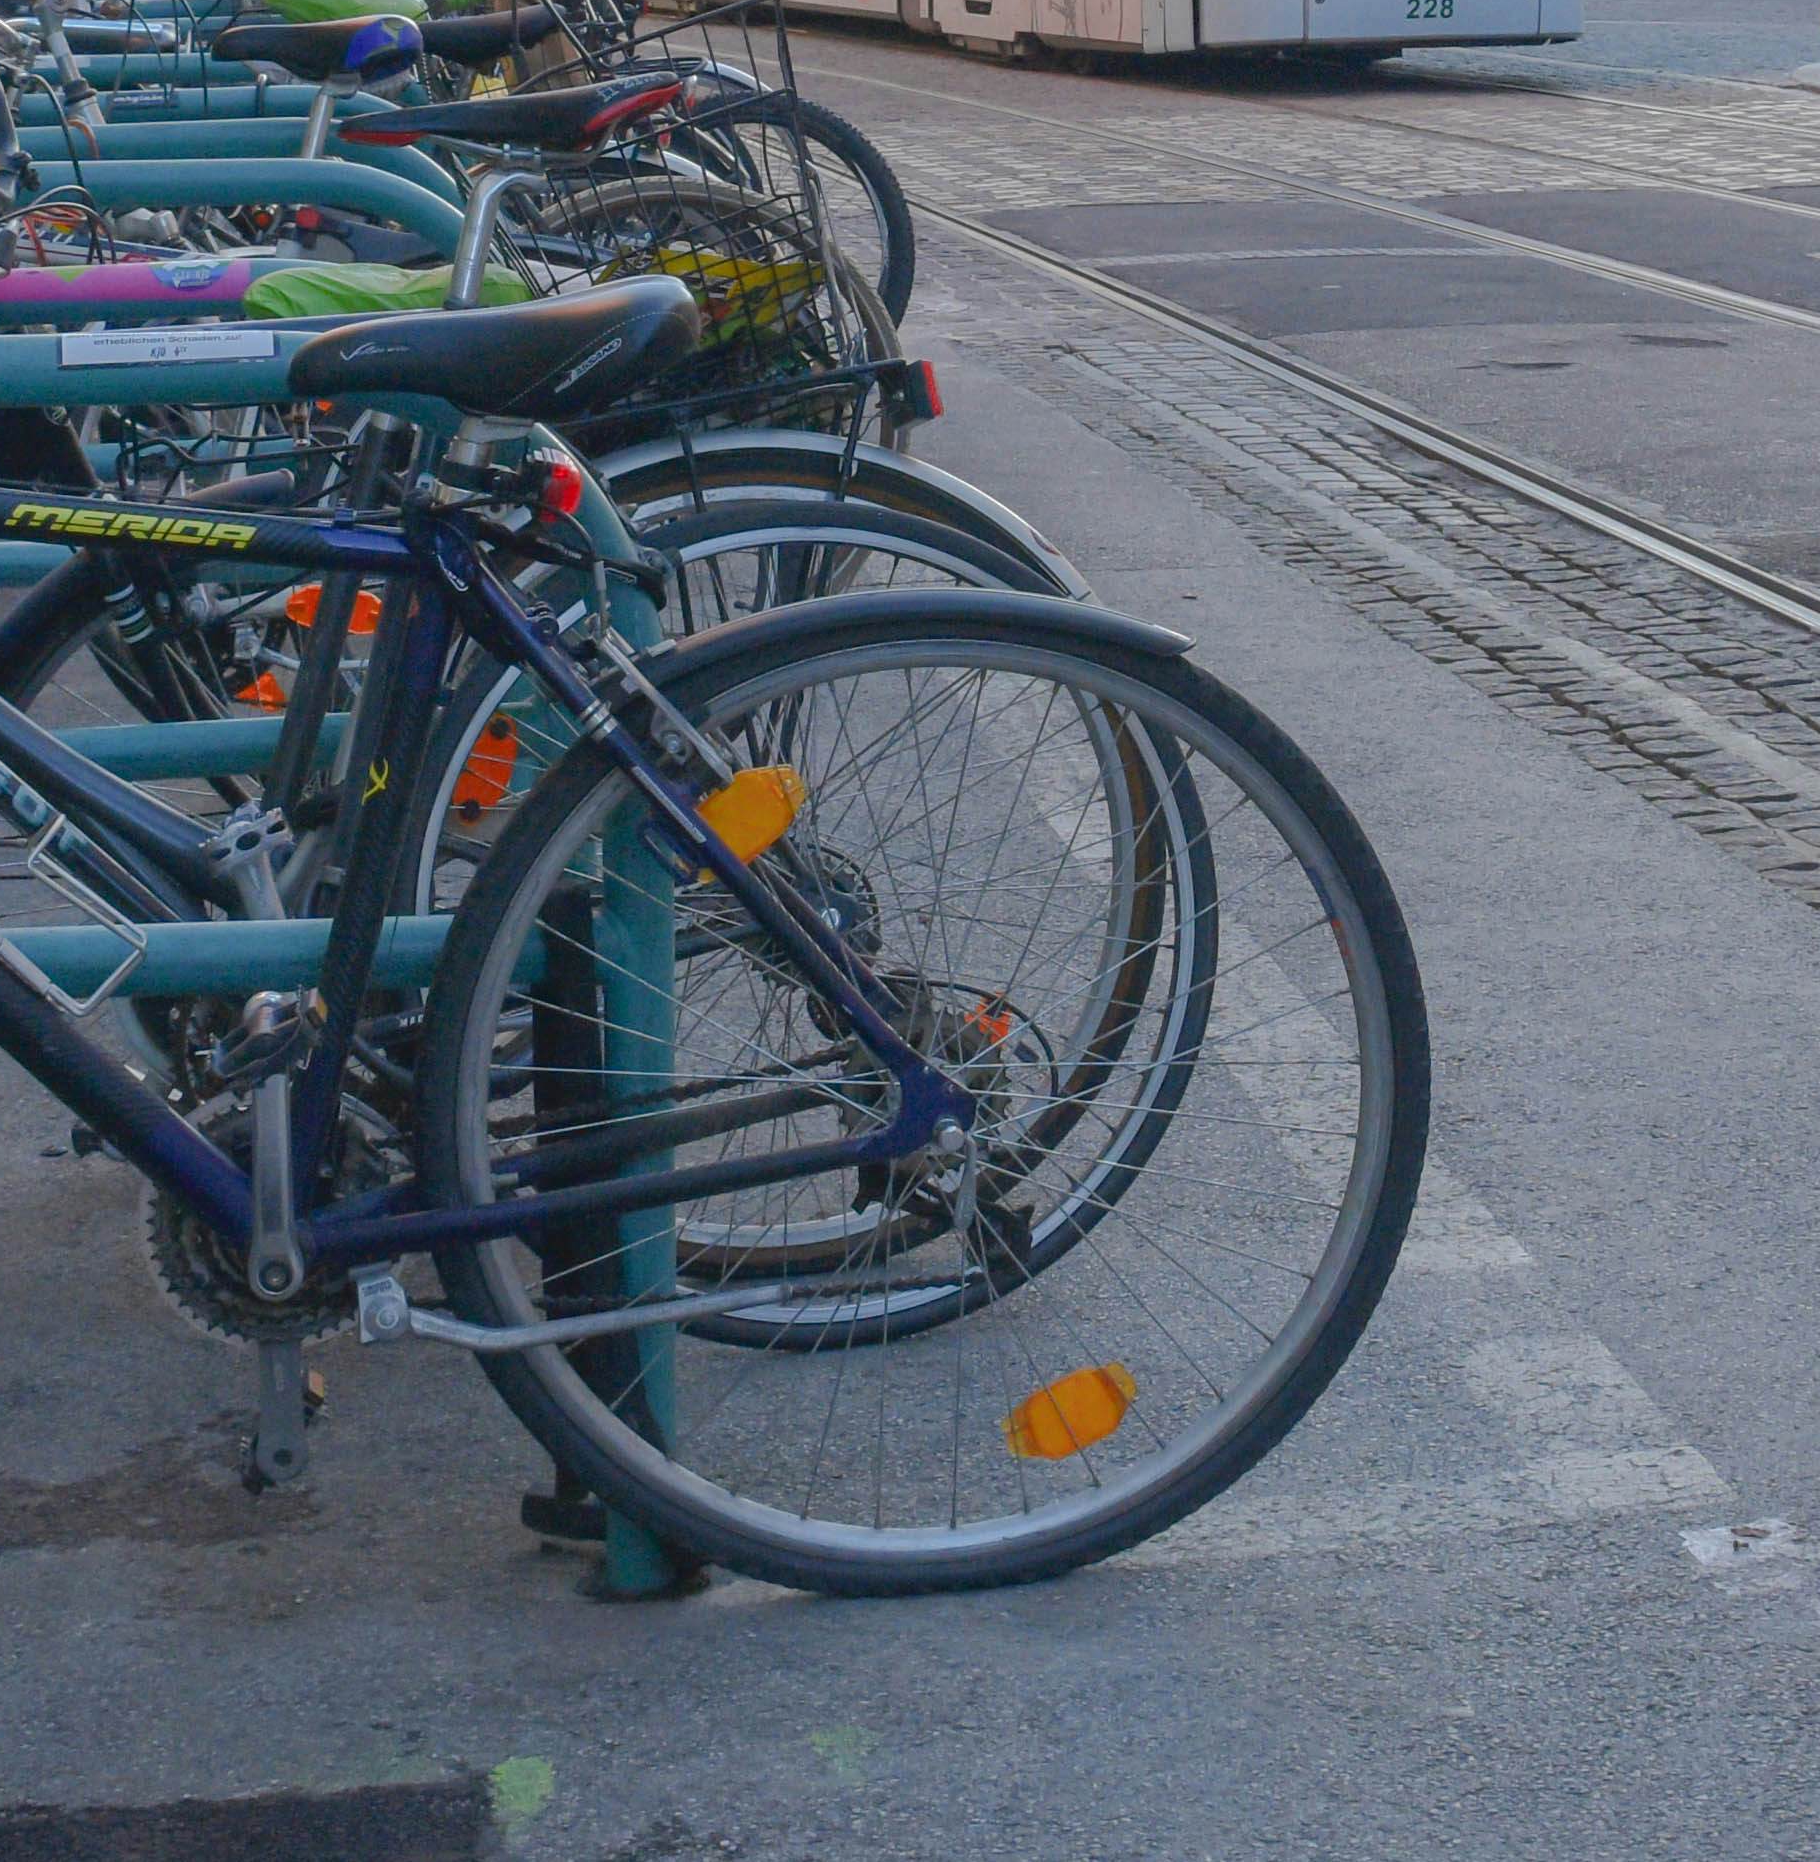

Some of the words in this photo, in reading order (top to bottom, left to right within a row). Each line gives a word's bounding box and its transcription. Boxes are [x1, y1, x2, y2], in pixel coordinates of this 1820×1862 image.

[93, 336, 165, 346] erheblichen
[167, 334, 221, 344] Schaden
[3, 501, 257, 550] MERIDA
